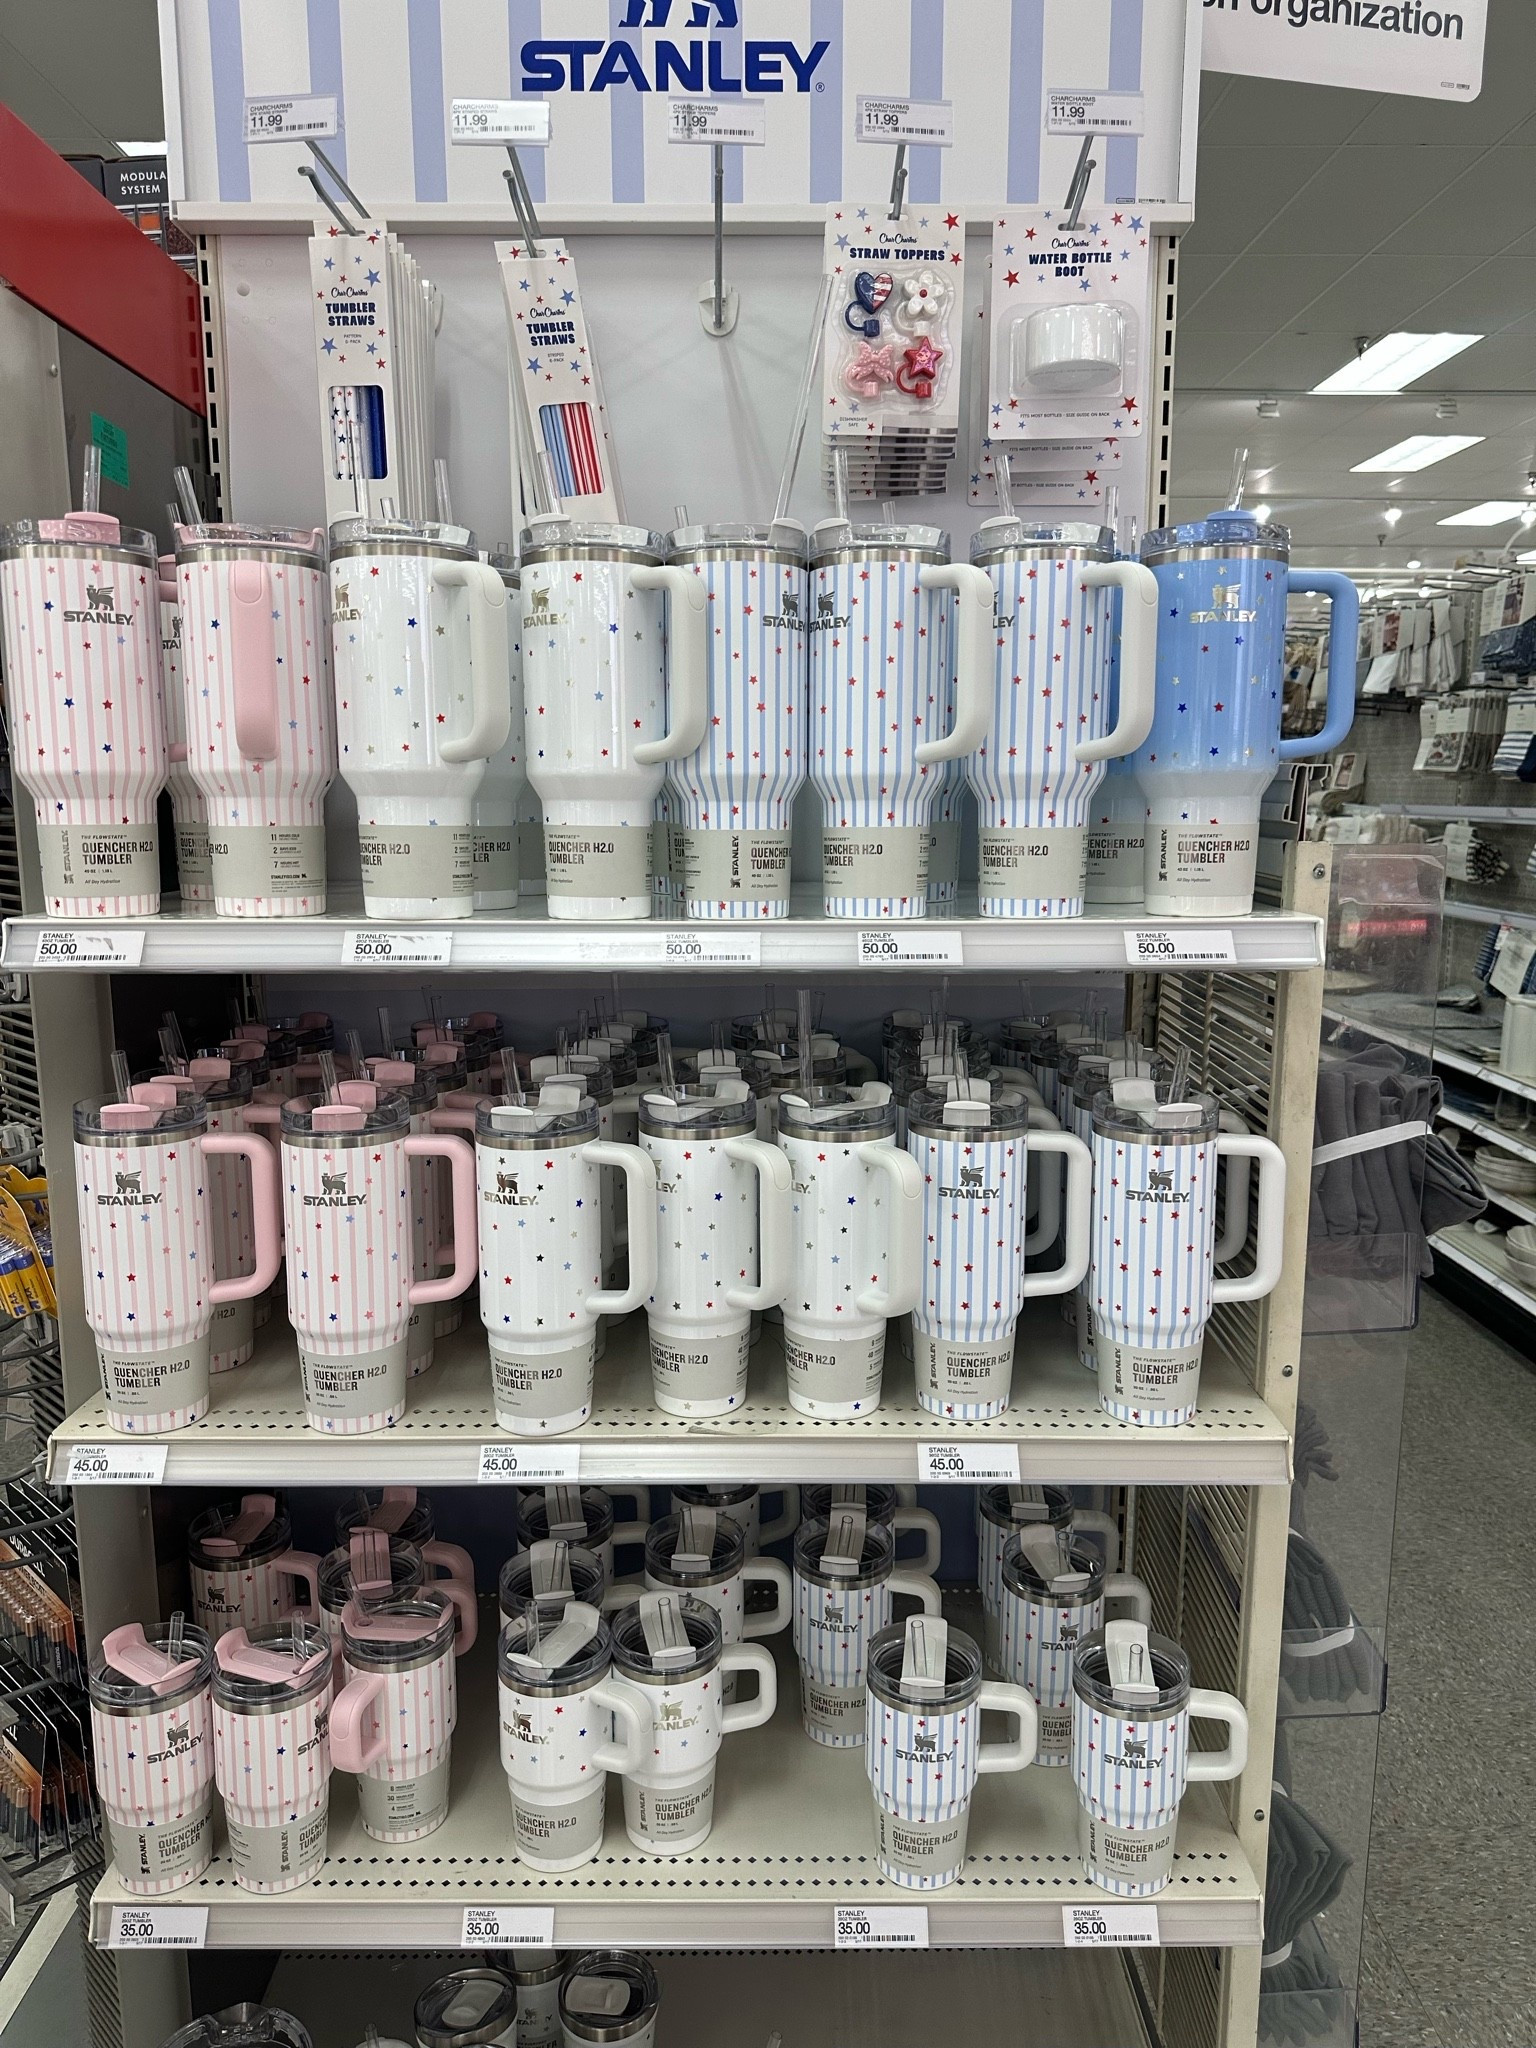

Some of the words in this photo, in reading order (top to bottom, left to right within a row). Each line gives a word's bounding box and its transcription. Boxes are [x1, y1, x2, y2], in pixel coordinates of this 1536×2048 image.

[520, 40, 831, 92] STANLEY
[1051, 95, 1095, 103] CHARCHARMS
[250, 102, 293, 113] CHARCHARMS
[672, 104, 718, 112] CHARCHARMS
[864, 102, 909, 111] CHARCHARMS
[1052, 106, 1084, 118] 11.99
[251, 114, 282, 128] 11.99
[455, 114, 487, 126] 11.99
[674, 114, 707, 127] 11.99
[866, 112, 899, 126] 11.99
[121, 185, 161, 196] SYSTEM
[849, 247, 890, 259] STRAW
[894, 248, 945, 261] TOPPERS
[1028, 253, 1067, 265] WATER
[1071, 252, 1112, 264] BOTTLE
[1055, 266, 1084, 277] BOOT
[325, 302, 376, 314] TUMBLER
[328, 315, 375, 327] STRAWS
[526, 321, 575, 334] TUMBLER
[530, 333, 575, 347] STRAWS
[63, 610, 133, 626] STANLEY
[523, 612, 567, 629] STANLEY
[1189, 610, 1256, 624] STANLEY
[808, 615, 851, 633] STANLEY
[82, 841, 137, 854] QUENCHER
[139, 841, 153, 853] H2.0
[389, 843, 411, 855] H2.0
[496, 841, 511, 852] H2.0
[548, 841, 591, 853] QUENCHER
[593, 842, 614, 854] H2.0
[862, 844, 883, 855] H2.0
[1127, 838, 1145, 849] H2.0
[1160, 829, 1168, 870] STANLEY
[1177, 840, 1232, 852] QUENCHER
[1234, 840, 1250, 851] H2.0
[731, 835, 739, 876] STANLEY
[751, 847, 789, 858] QUENCHER
[982, 845, 1025, 856] QUENCHER
[1027, 845, 1049, 856] H2.0
[82, 853, 132, 866] TUMBLER
[549, 853, 584, 865] TUMBLER
[751, 858, 786, 870] TUMBLER
[983, 856, 1018, 868] TUMBLER
[1177, 852, 1225, 864] TUMBLER
[40, 943, 77, 955] 50.00
[354, 943, 392, 955] 50.00
[666, 943, 702, 955] 50.00
[862, 943, 898, 954] 50.00
[1138, 942, 1175, 954] 50.00
[97, 1192, 162, 1206] STANLEY
[483, 1191, 538, 1206] STANLEY
[938, 1186, 999, 1199] STANLEY
[1125, 1189, 1189, 1203] STANLEY
[303, 1193, 367, 1207] STANLEY
[688, 1354, 709, 1365] H2.0
[815, 1354, 836, 1366] H2.0
[929, 1342, 937, 1378] STANLEY
[947, 1356, 997, 1368] QUENCHER
[998, 1351, 1011, 1364] H2.0
[1114, 1347, 1122, 1383] STANLEY
[113, 1365, 167, 1378] QUENCHER
[170, 1359, 190, 1374] H2.0
[313, 1369, 365, 1381] QUENCHER
[367, 1364, 387, 1378] H2.0
[495, 1363, 539, 1380] QUENCHER
[541, 1367, 563, 1380] H2.0
[947, 1366, 991, 1378] TUMBLER
[1132, 1362, 1184, 1375] QUENCHER
[115, 1377, 161, 1388] TUMBLER
[495, 1373, 533, 1390] TUMBLER
[1132, 1372, 1178, 1385] TUMBLER
[314, 1379, 358, 1392] TUMBLER
[73, 1459, 109, 1472] 45.00
[482, 1458, 518, 1471] 45.00
[930, 1458, 964, 1471] 45.00
[810, 1618, 858, 1633] STANLEY
[809, 1694, 849, 1709] QUENCHER
[850, 1698, 866, 1709] H2.0
[810, 1702, 844, 1717] TUMBLER
[503, 1721, 550, 1745] STANLEY
[146, 1732, 203, 1764] STANLEY
[895, 1749, 953, 1763] STANLEY
[1103, 1753, 1163, 1770] STANLEY
[655, 1794, 700, 1813] QUENCHER
[701, 1783, 713, 1800] H2.0
[655, 1807, 696, 1821] TUMBLER
[557, 1816, 577, 1829] H2.0
[158, 1820, 205, 1849] QUENCHER
[892, 1830, 940, 1846] QUENCHER
[942, 1829, 958, 1844] H2.0
[138, 1833, 147, 1865] STANLEY
[158, 1831, 201, 1858] TUMBLER
[281, 1830, 289, 1863] STANLEY
[893, 1838, 934, 1855] TUMBLER
[1104, 1838, 1154, 1854] QUENCHER
[1155, 1836, 1170, 1851] H2.0
[1104, 1846, 1148, 1862] TUMBLER
[122, 1911, 150, 1919] STANLEY
[1072, 1909, 1100, 1917] STANLEY
[120, 1923, 154, 1936] 35.00
[466, 1922, 500, 1935] 35.00
[838, 1921, 870, 1935] 35.00
[1074, 1921, 1107, 1935] 35.00
